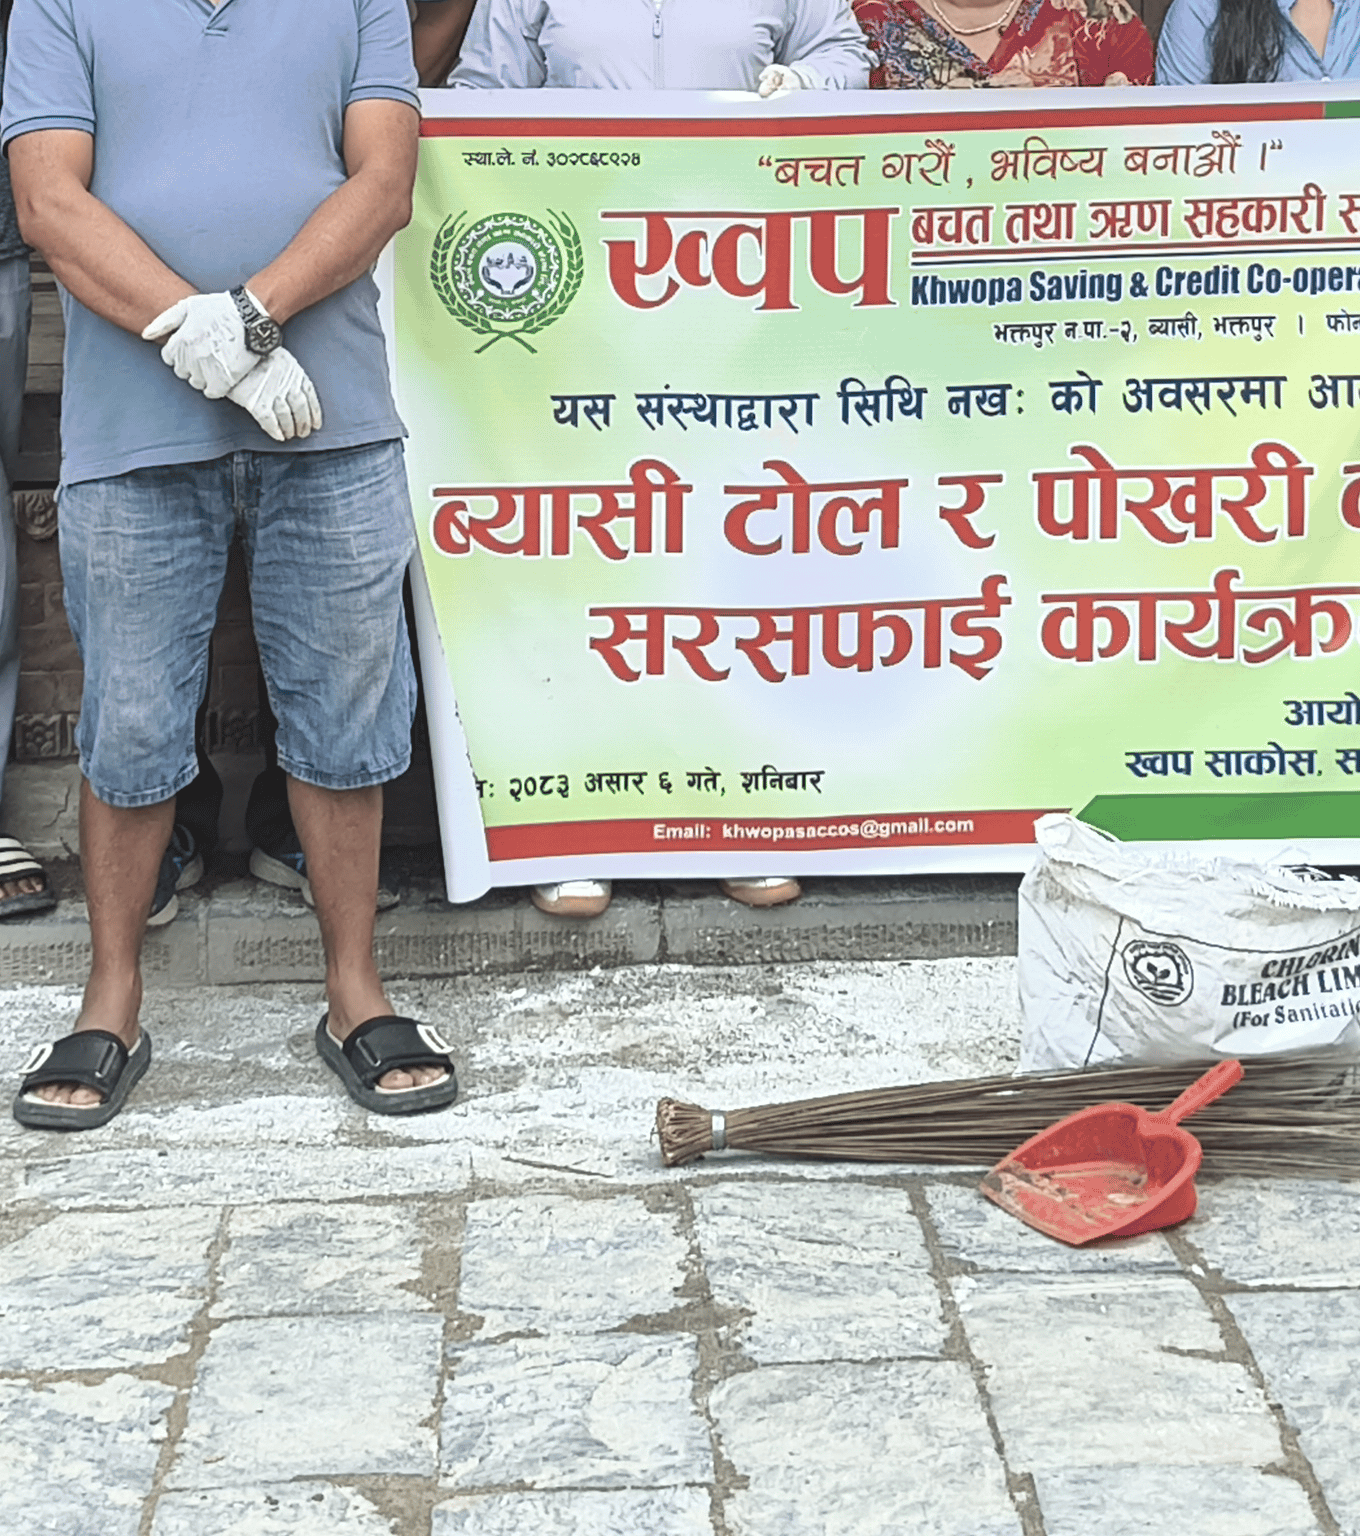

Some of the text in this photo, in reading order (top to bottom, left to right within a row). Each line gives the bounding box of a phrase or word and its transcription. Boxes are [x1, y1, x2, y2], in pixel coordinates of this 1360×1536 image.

[991, 136, 1108, 182] भविष्य
[911, 207, 993, 244] बचत
[1006, 202, 1077, 243] तथा
[1089, 199, 1172, 237] ऋण
[1184, 184, 1327, 236] सहकारी
[602, 208, 900, 310] ख्वप
[912, 276, 1021, 305] Khwopa
[1030, 270, 1122, 302] Saving
[1130, 272, 1148, 297] &
[1156, 265, 1240, 296] Credit
[994, 323, 1057, 348] भक्तपुर
[1213, 316, 1276, 341] भक्तपुर
[550, 394, 616, 431] यस
[635, 384, 820, 434] संस्थाद्वारा
[836, 375, 928, 426] सिथि
[1049, 370, 1103, 414] को
[1123, 376, 1287, 417] अवसरमा
[433, 460, 693, 560] ब्यासी
[724, 460, 908, 556] टोल
[939, 475, 1002, 549] र
[1033, 443, 1314, 544] पोखरी
[589, 575, 1012, 683] सरसफाई
[510, 775, 569, 802] २०८३
[585, 772, 648, 795] असार
[659, 772, 672, 794] ६
[686, 767, 725, 796] गते,
[740, 765, 825, 793] शनिबार
[1125, 751, 1194, 777] ख्वप
[654, 824, 710, 839] Email:
[1221, 973, 1310, 1006] BLEACH
[1233, 1011, 1270, 1029] (For
